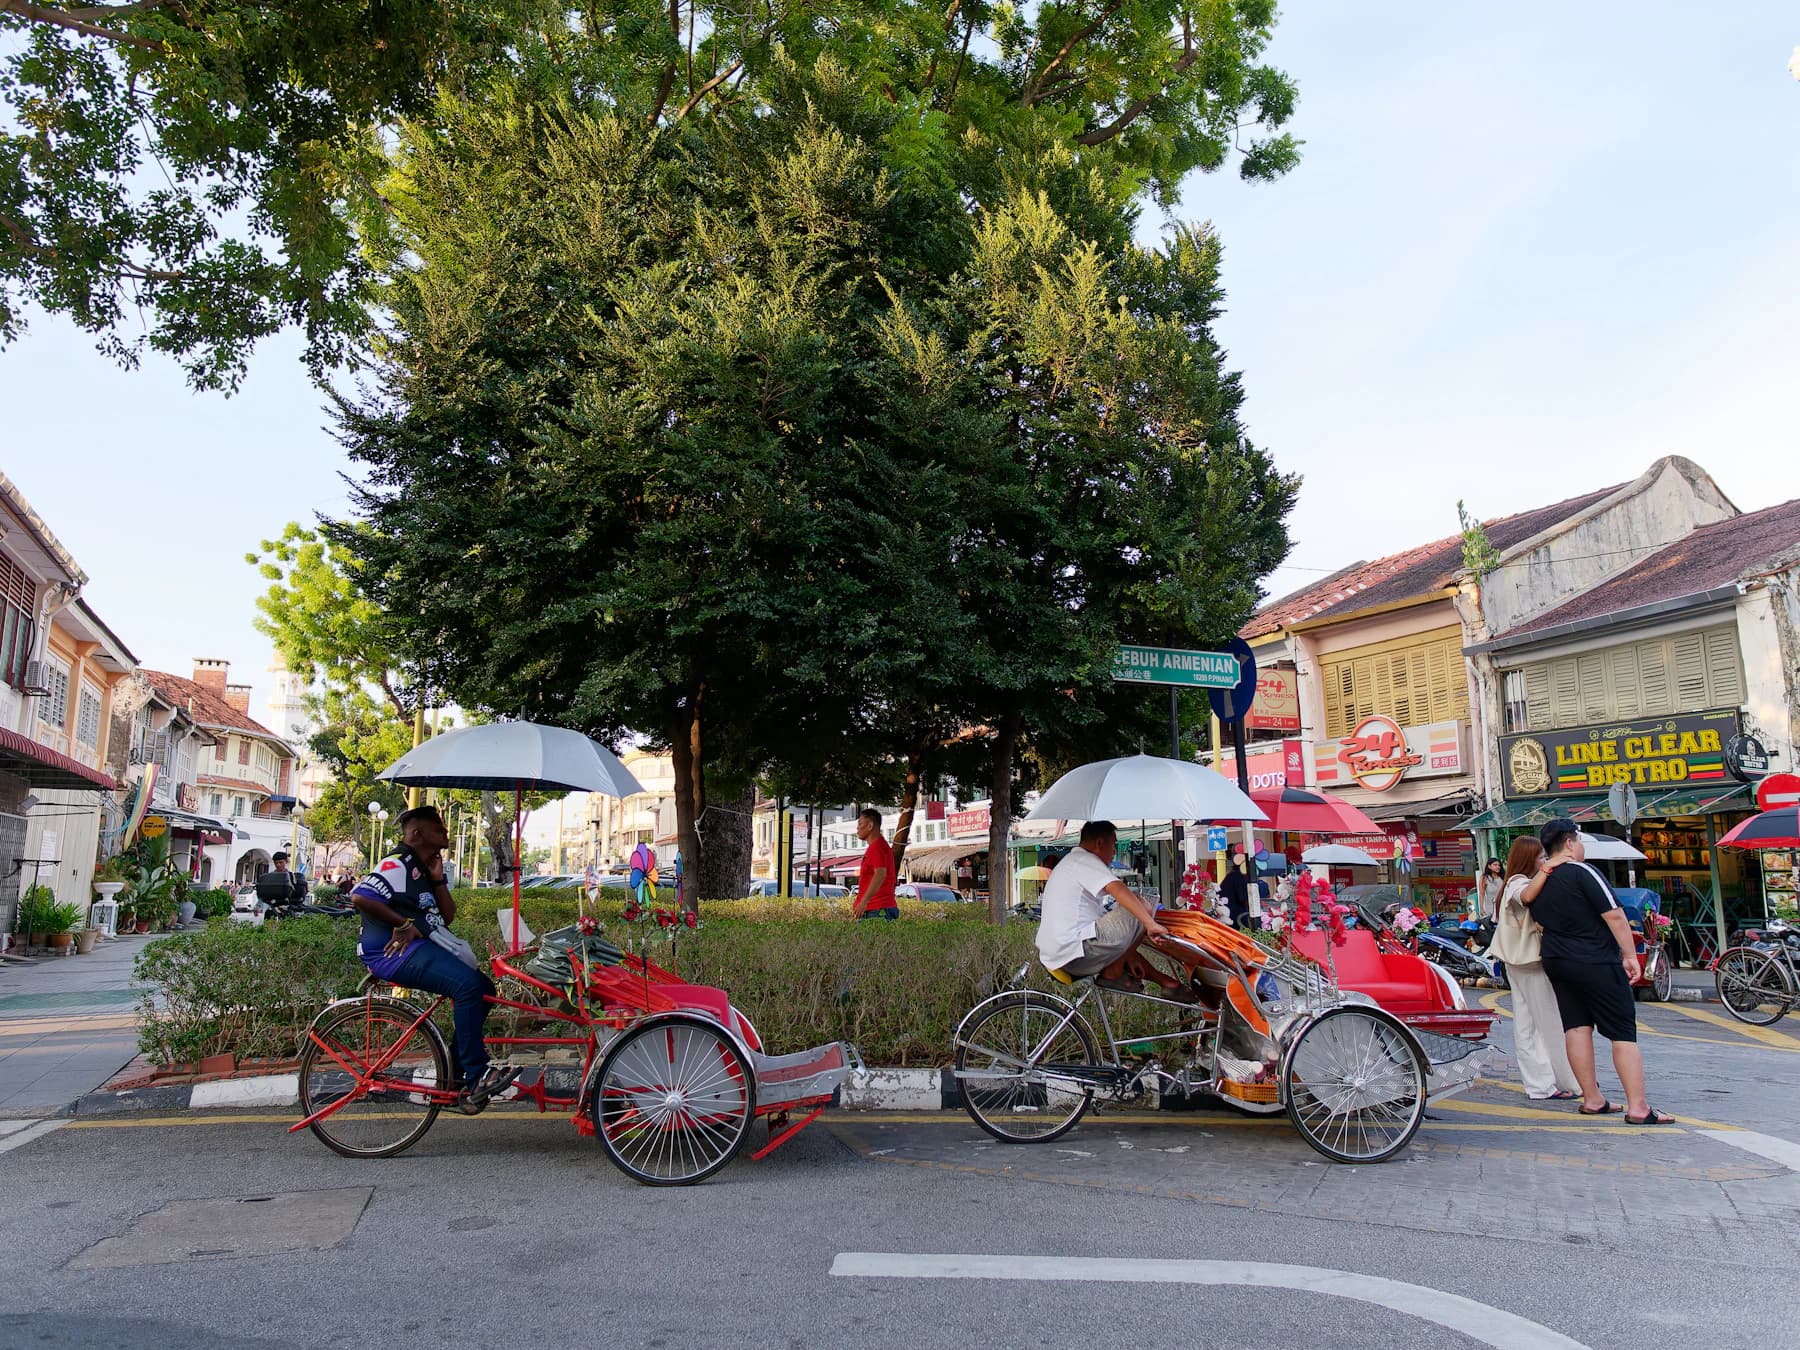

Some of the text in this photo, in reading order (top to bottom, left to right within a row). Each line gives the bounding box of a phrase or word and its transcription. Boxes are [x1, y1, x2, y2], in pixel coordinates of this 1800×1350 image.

[1162, 654, 1234, 674] ARMENIAN
[1256, 679, 1285, 693] 24
[1338, 731, 1400, 763] 24
[1555, 740, 1619, 766] LINE
[1623, 728, 1723, 760] CLEAR
[1253, 772, 1286, 789] DOTS
[1587, 758, 1688, 787] BISTRO
[1333, 836, 1363, 845] INTERNET
